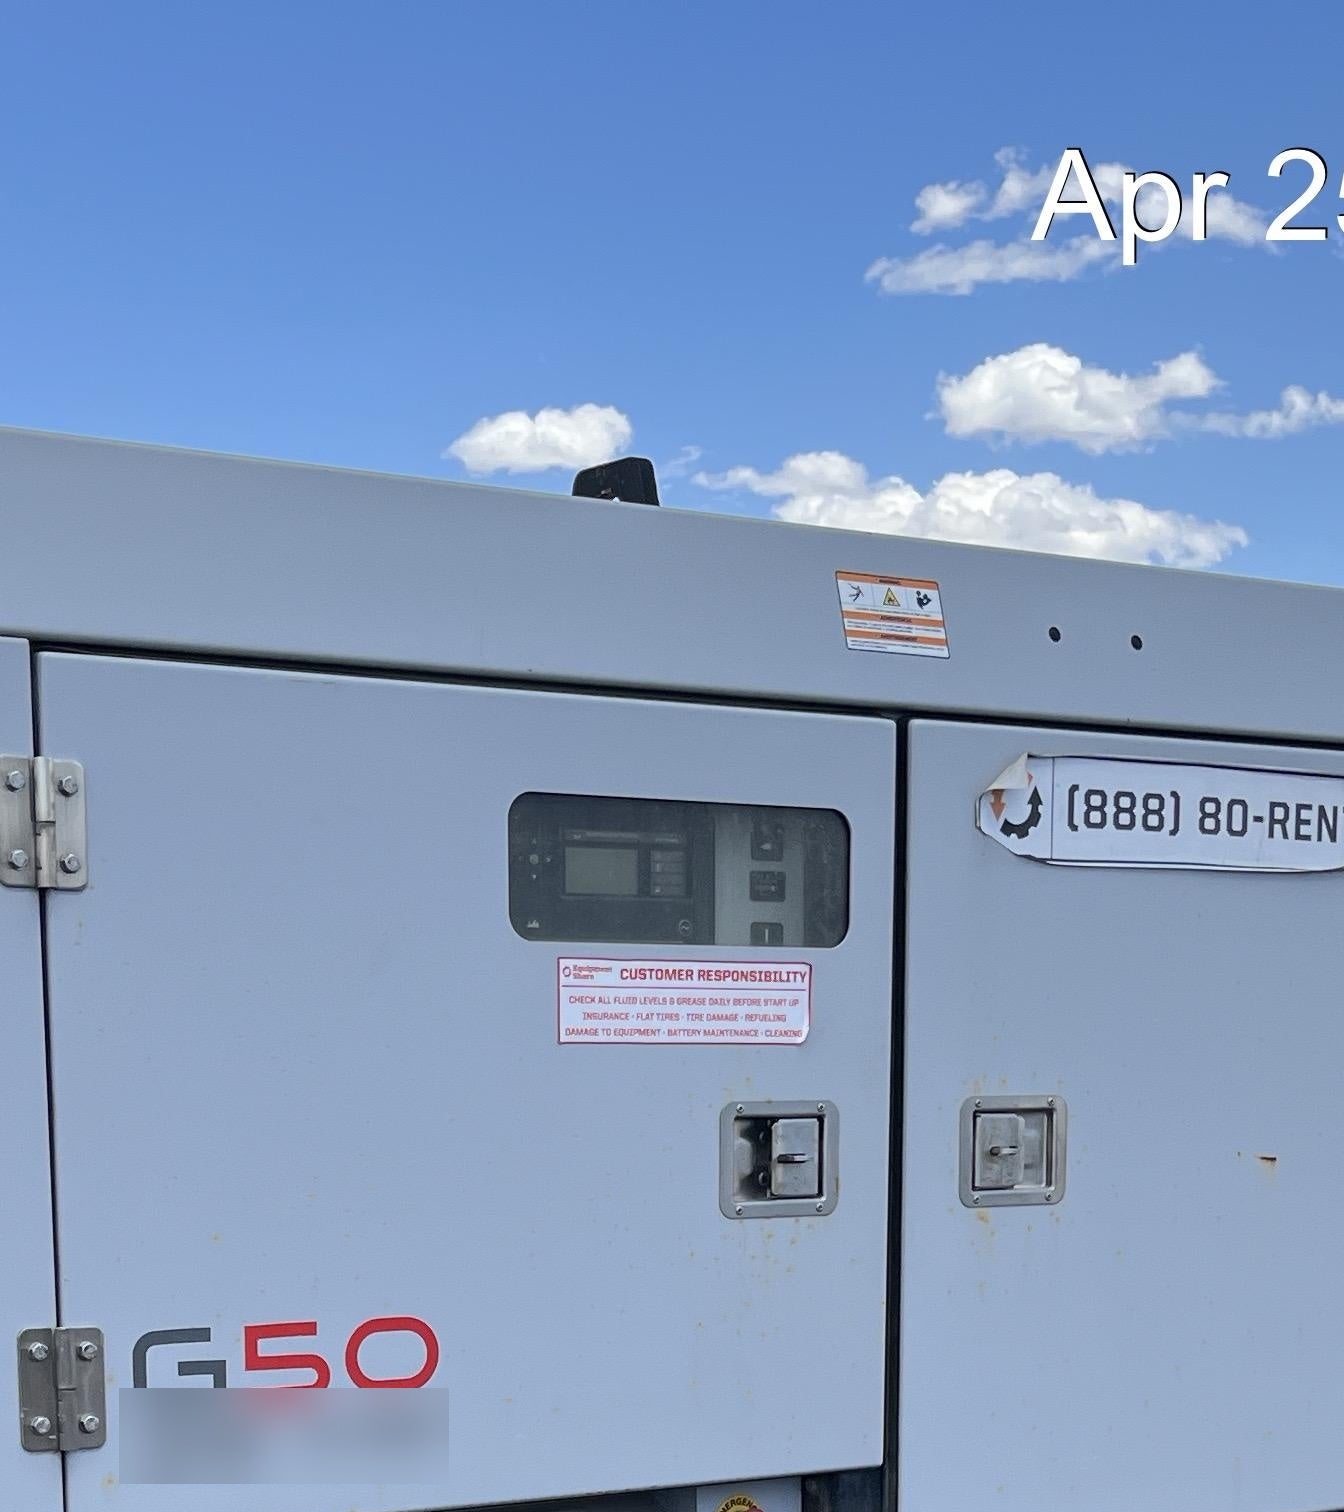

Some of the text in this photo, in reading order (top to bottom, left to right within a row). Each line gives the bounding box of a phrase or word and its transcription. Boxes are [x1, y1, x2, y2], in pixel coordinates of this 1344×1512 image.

[1067, 784, 1181, 836] (888)
[620, 968, 807, 983] CUSTOMER RESPONSIBILITY
[569, 996, 595, 1004] CHECK
[597, 996, 611, 1005] ALL
[613, 996, 637, 1005] FLUID
[639, 997, 668, 1005] LEVELS
[677, 997, 706, 1006] GREASE
[708, 998, 731, 1006] DAILY
[733, 998, 761, 1007] BEFORE
[763, 998, 787, 1007] START
[789, 998, 799, 1007] UP
[582, 1012, 786, 1022] INSURANCE FLAT TIRES TIRE DAMAGE REFUELING
[565, 1028, 802, 1038] DAMAGE TO EQUIPMENT BATTERY MAINTENANCE CLEANING
